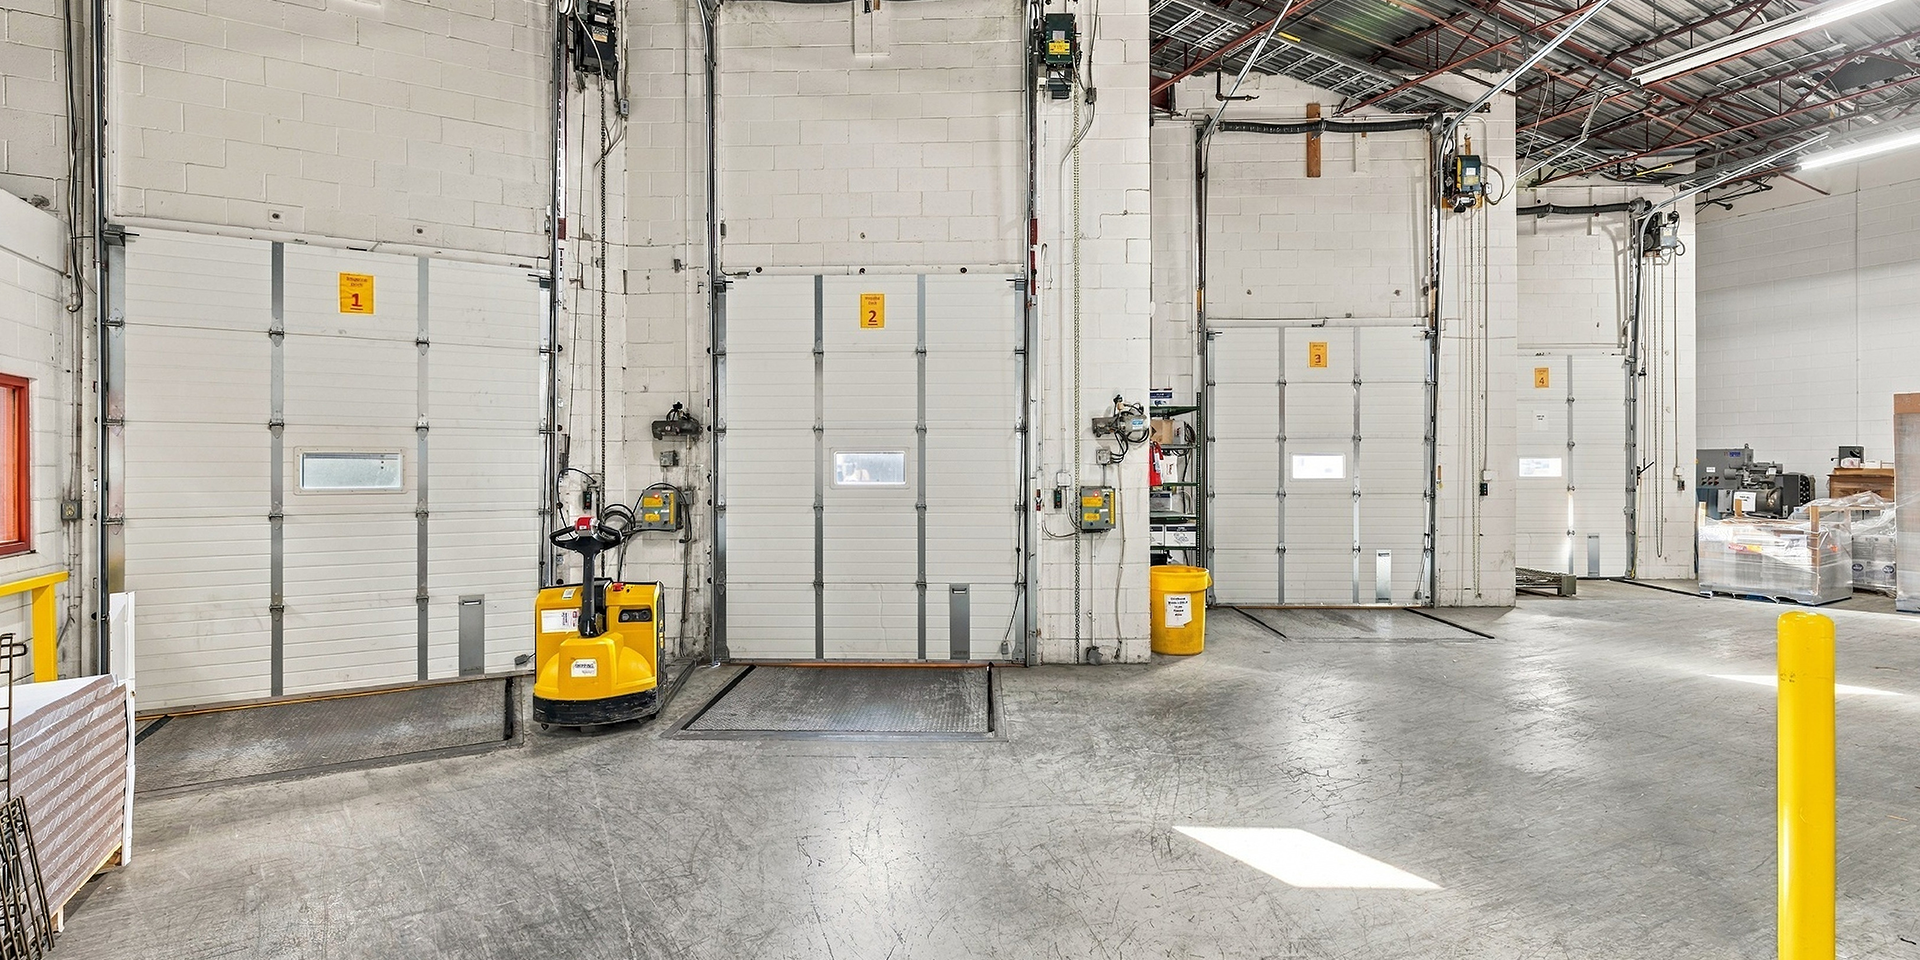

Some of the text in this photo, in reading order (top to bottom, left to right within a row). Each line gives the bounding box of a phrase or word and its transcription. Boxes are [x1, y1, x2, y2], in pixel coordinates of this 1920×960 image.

[352, 293, 362, 307] 1
[868, 310, 877, 322] 2
[1315, 354, 1321, 363] 3
[1539, 377, 1545, 385] 4
